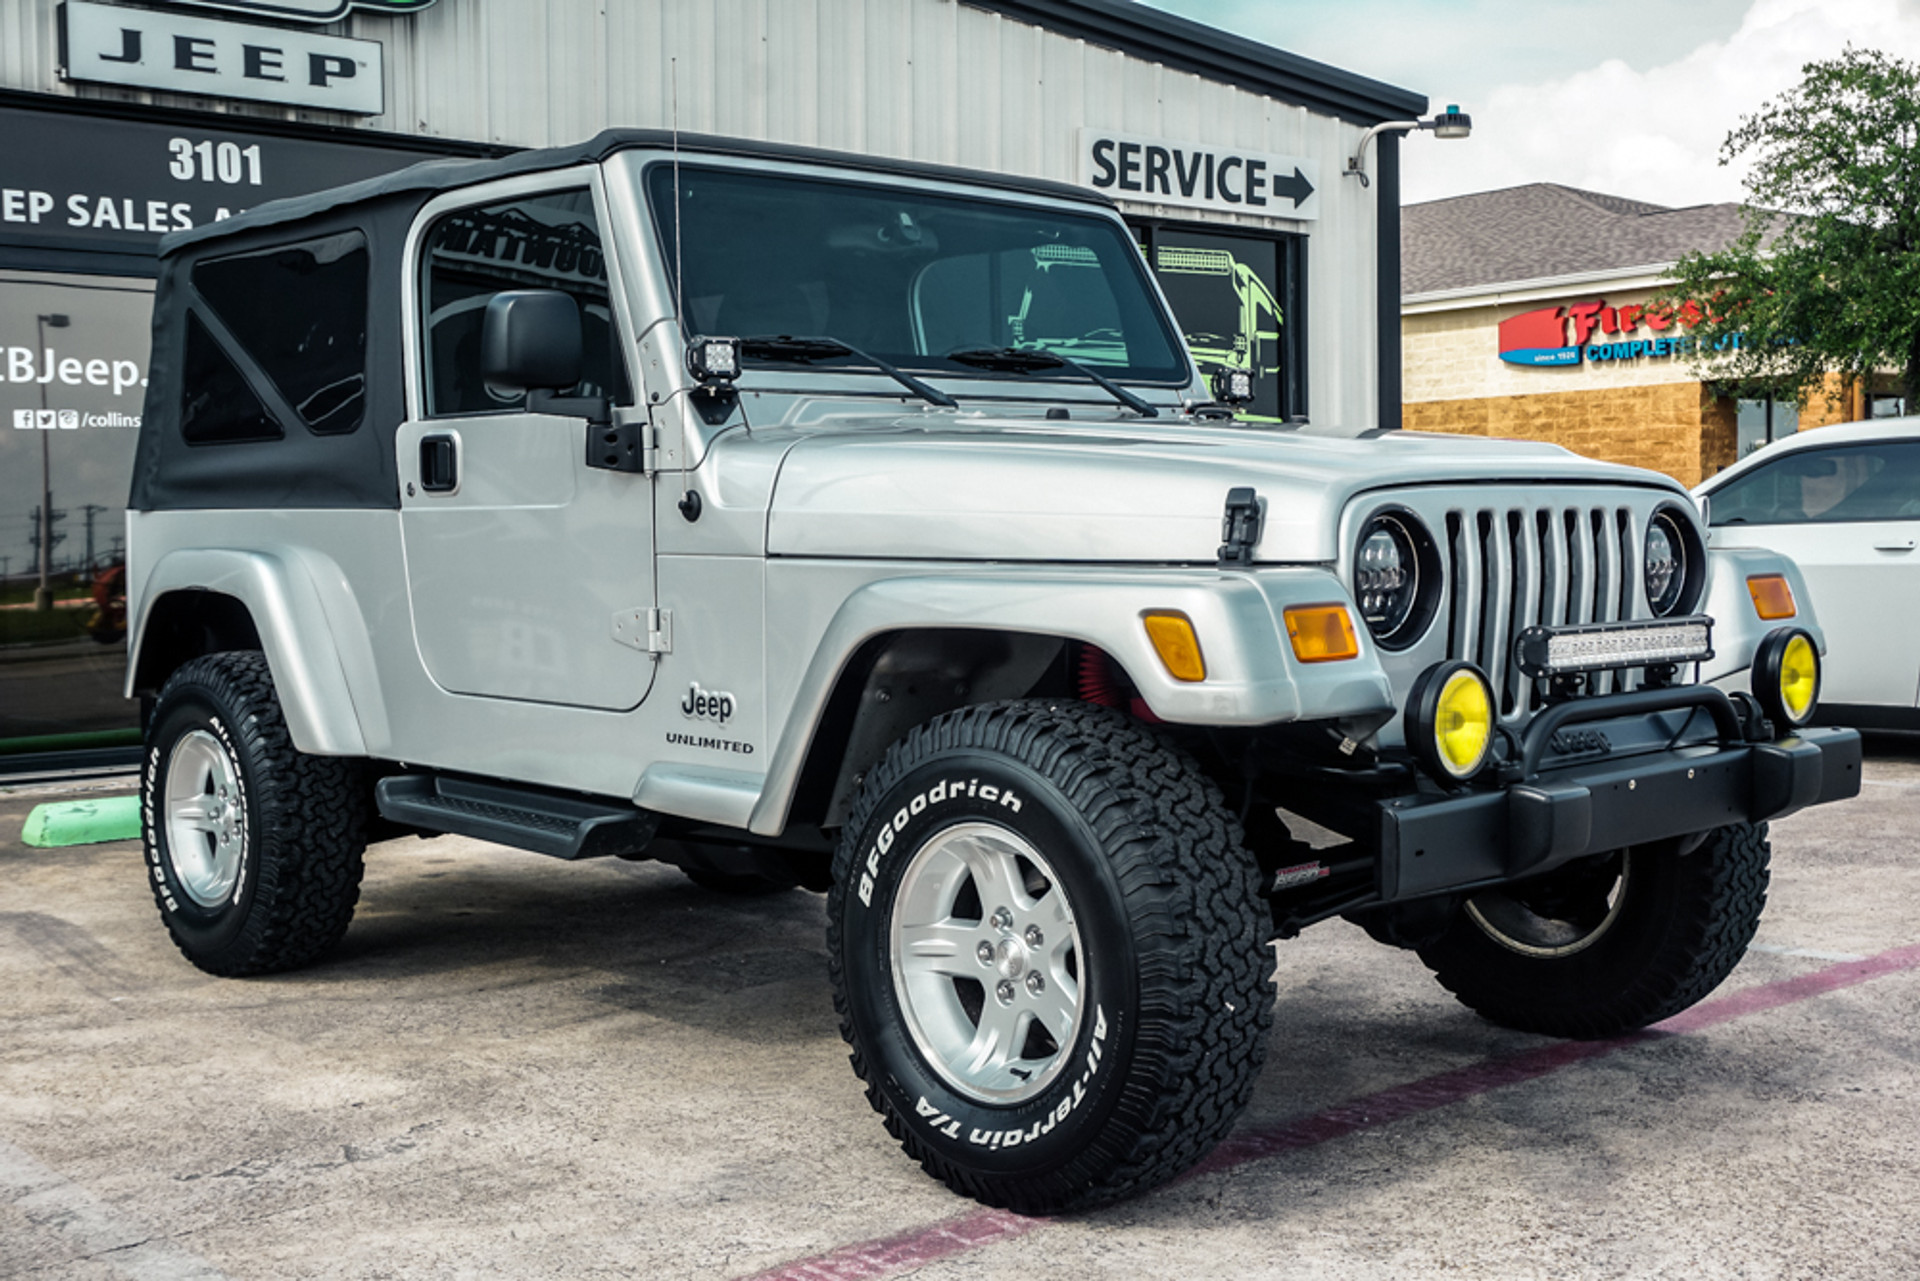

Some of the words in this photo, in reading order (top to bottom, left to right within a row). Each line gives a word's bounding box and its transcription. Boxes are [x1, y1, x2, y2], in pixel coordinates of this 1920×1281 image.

[98, 27, 357, 88] JEEP
[169, 137, 261, 185] 3101
[1092, 138, 1267, 206] SERVICE
[2, 188, 54, 223] EP
[66, 194, 193, 232] SALES
[0, 346, 149, 396] BJeep.
[81, 411, 143, 428] /collins
[681, 685, 734, 724] Jeep
[666, 732, 754, 754] UNLIMITED
[858, 778, 1023, 908] BFGoodrich
[968, 1003, 1108, 1150] All-Terrain
[915, 1096, 962, 1139] T/A
